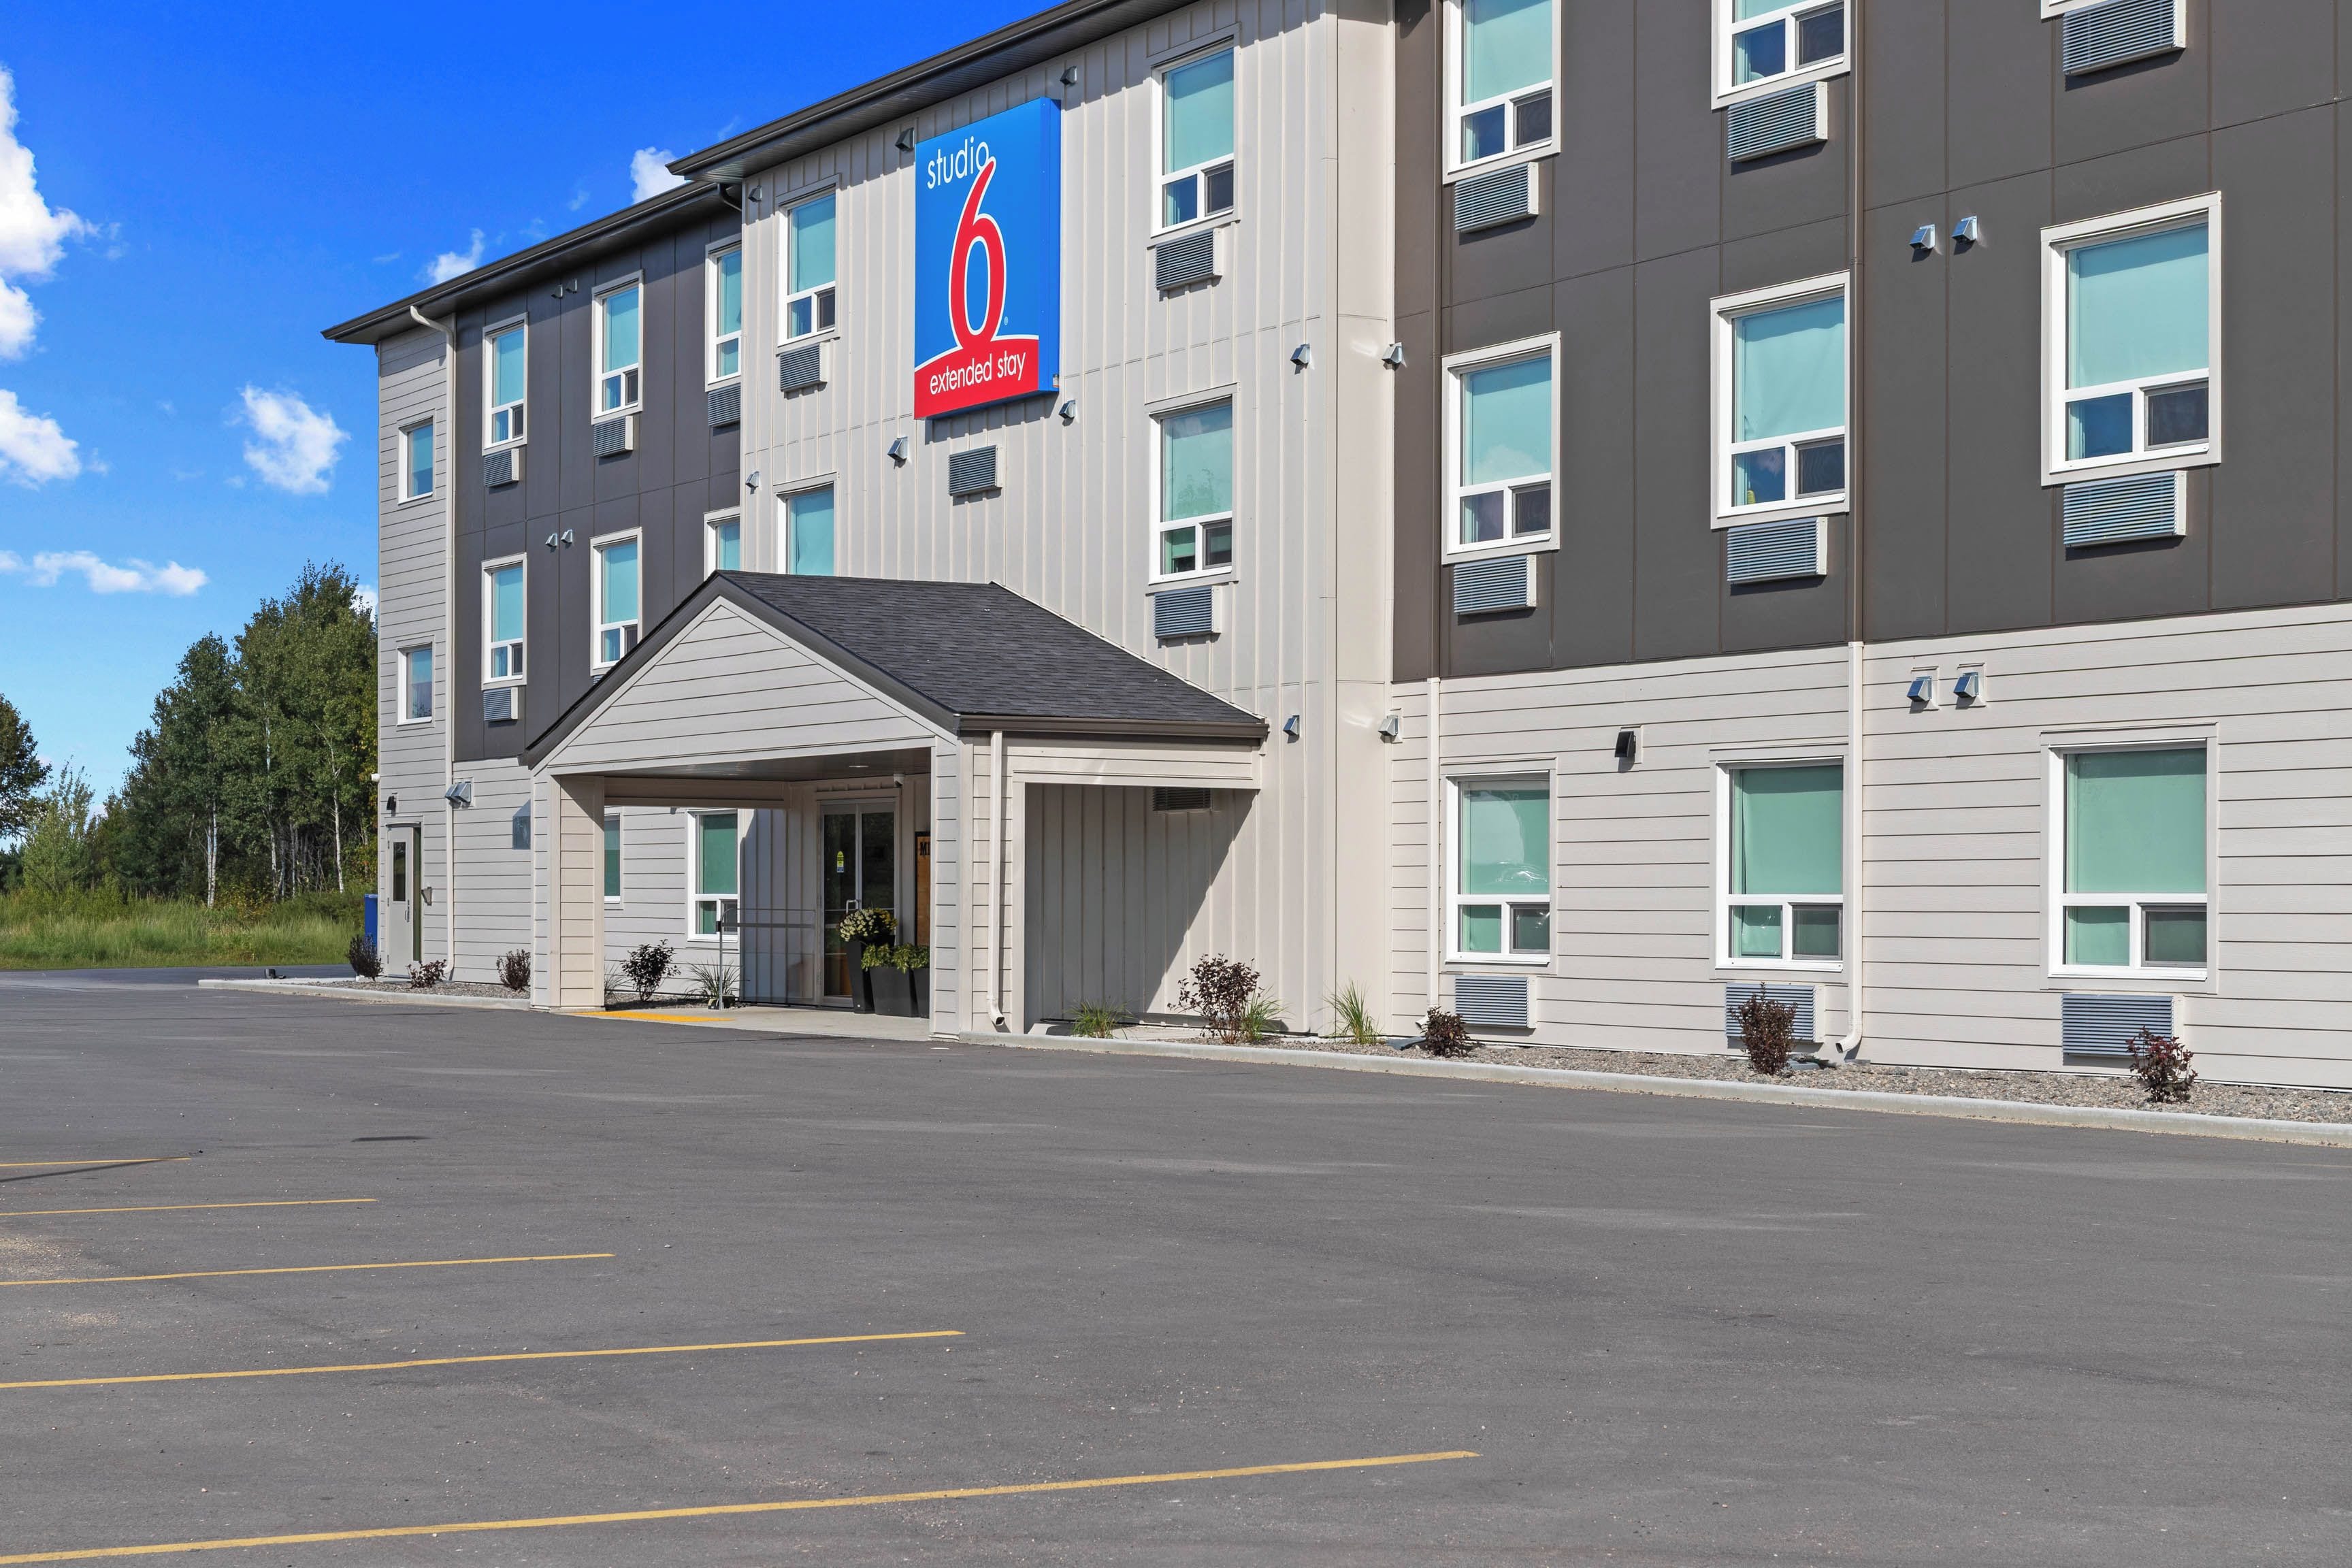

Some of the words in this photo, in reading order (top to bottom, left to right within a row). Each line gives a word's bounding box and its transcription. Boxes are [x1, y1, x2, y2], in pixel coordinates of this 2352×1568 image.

[927, 135, 990, 189] studio
[949, 156, 1006, 346] 6
[930, 353, 992, 395] extended
[997, 350, 1026, 381] stay
